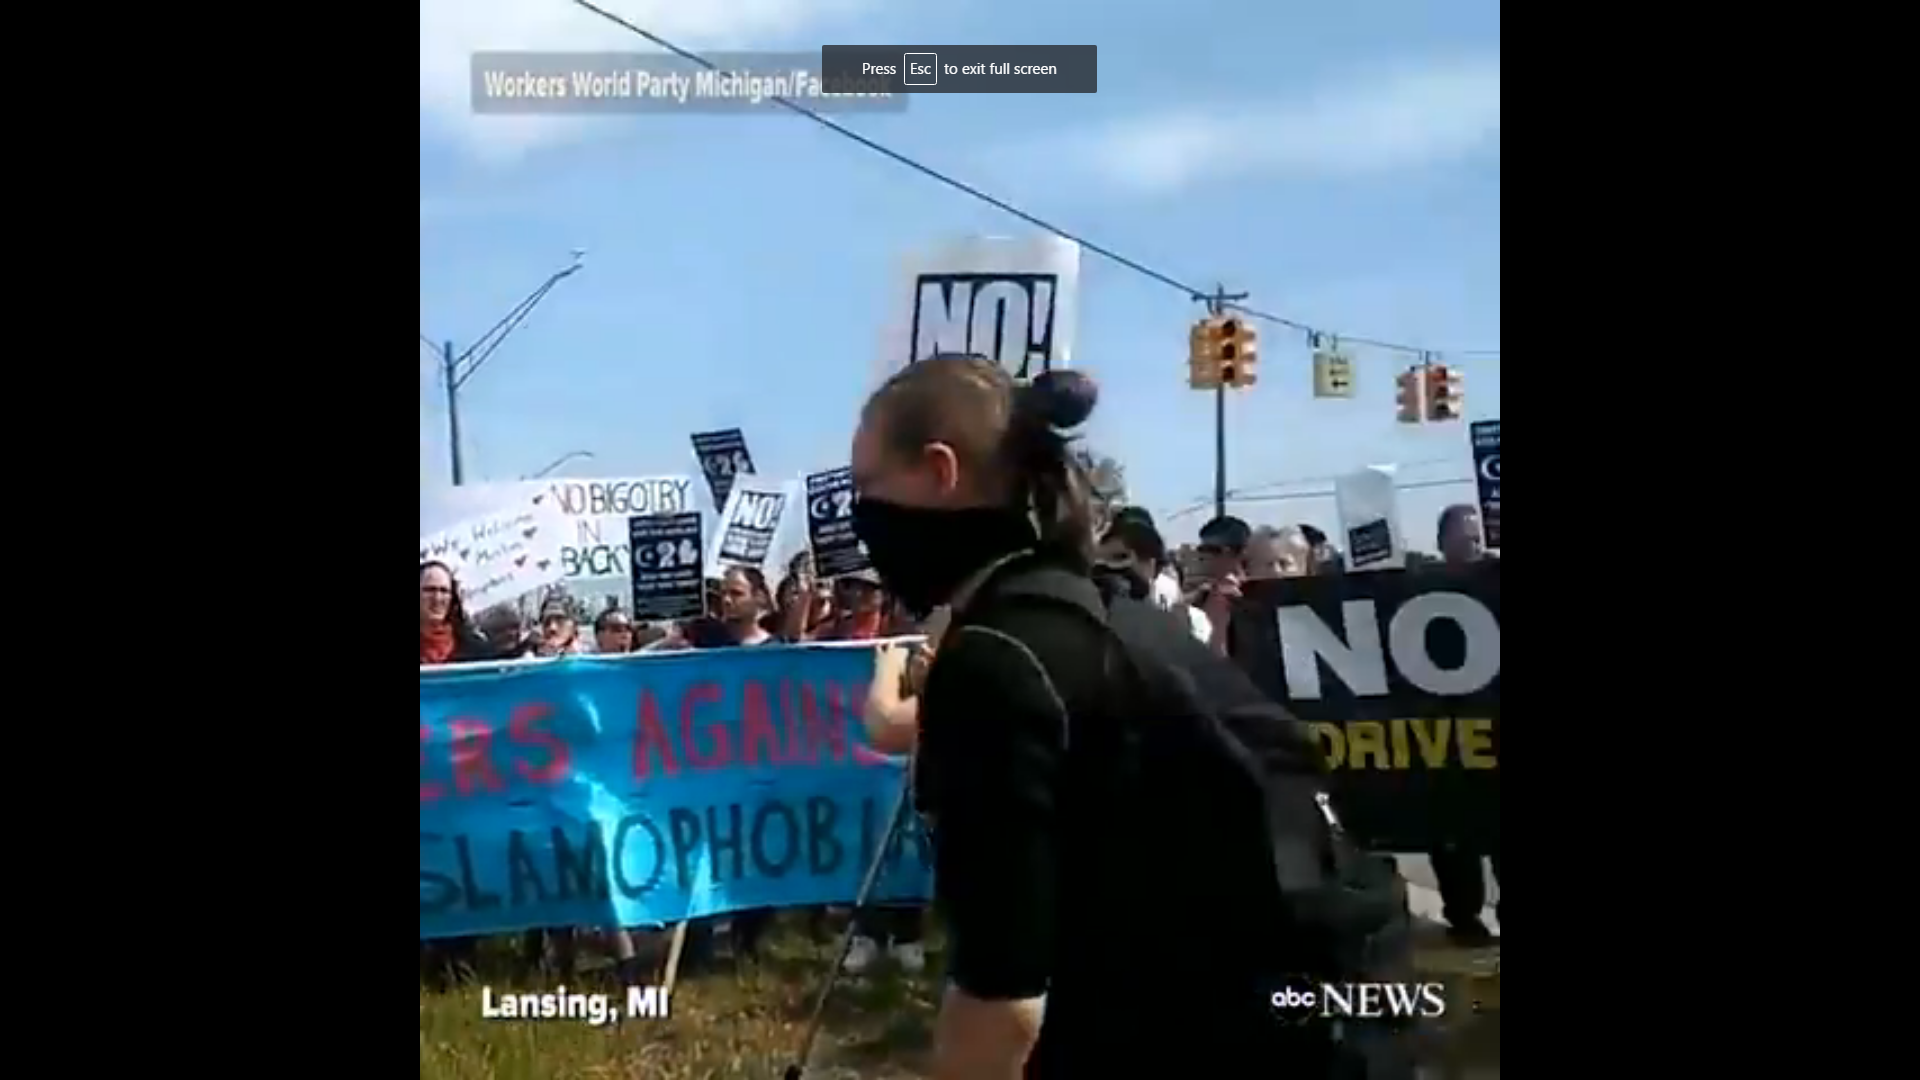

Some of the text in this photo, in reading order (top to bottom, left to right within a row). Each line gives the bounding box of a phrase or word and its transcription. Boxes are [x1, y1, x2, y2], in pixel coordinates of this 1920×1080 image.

[915, 280, 1052, 379] NO!
[552, 483, 586, 515] NO
[590, 479, 690, 515] BIGOTRY
[733, 493, 785, 530] NO!
[577, 519, 602, 543] IN
[560, 543, 632, 577] BACK
[1277, 590, 1501, 700] NO
[1307, 718, 1498, 771] DRIVE
